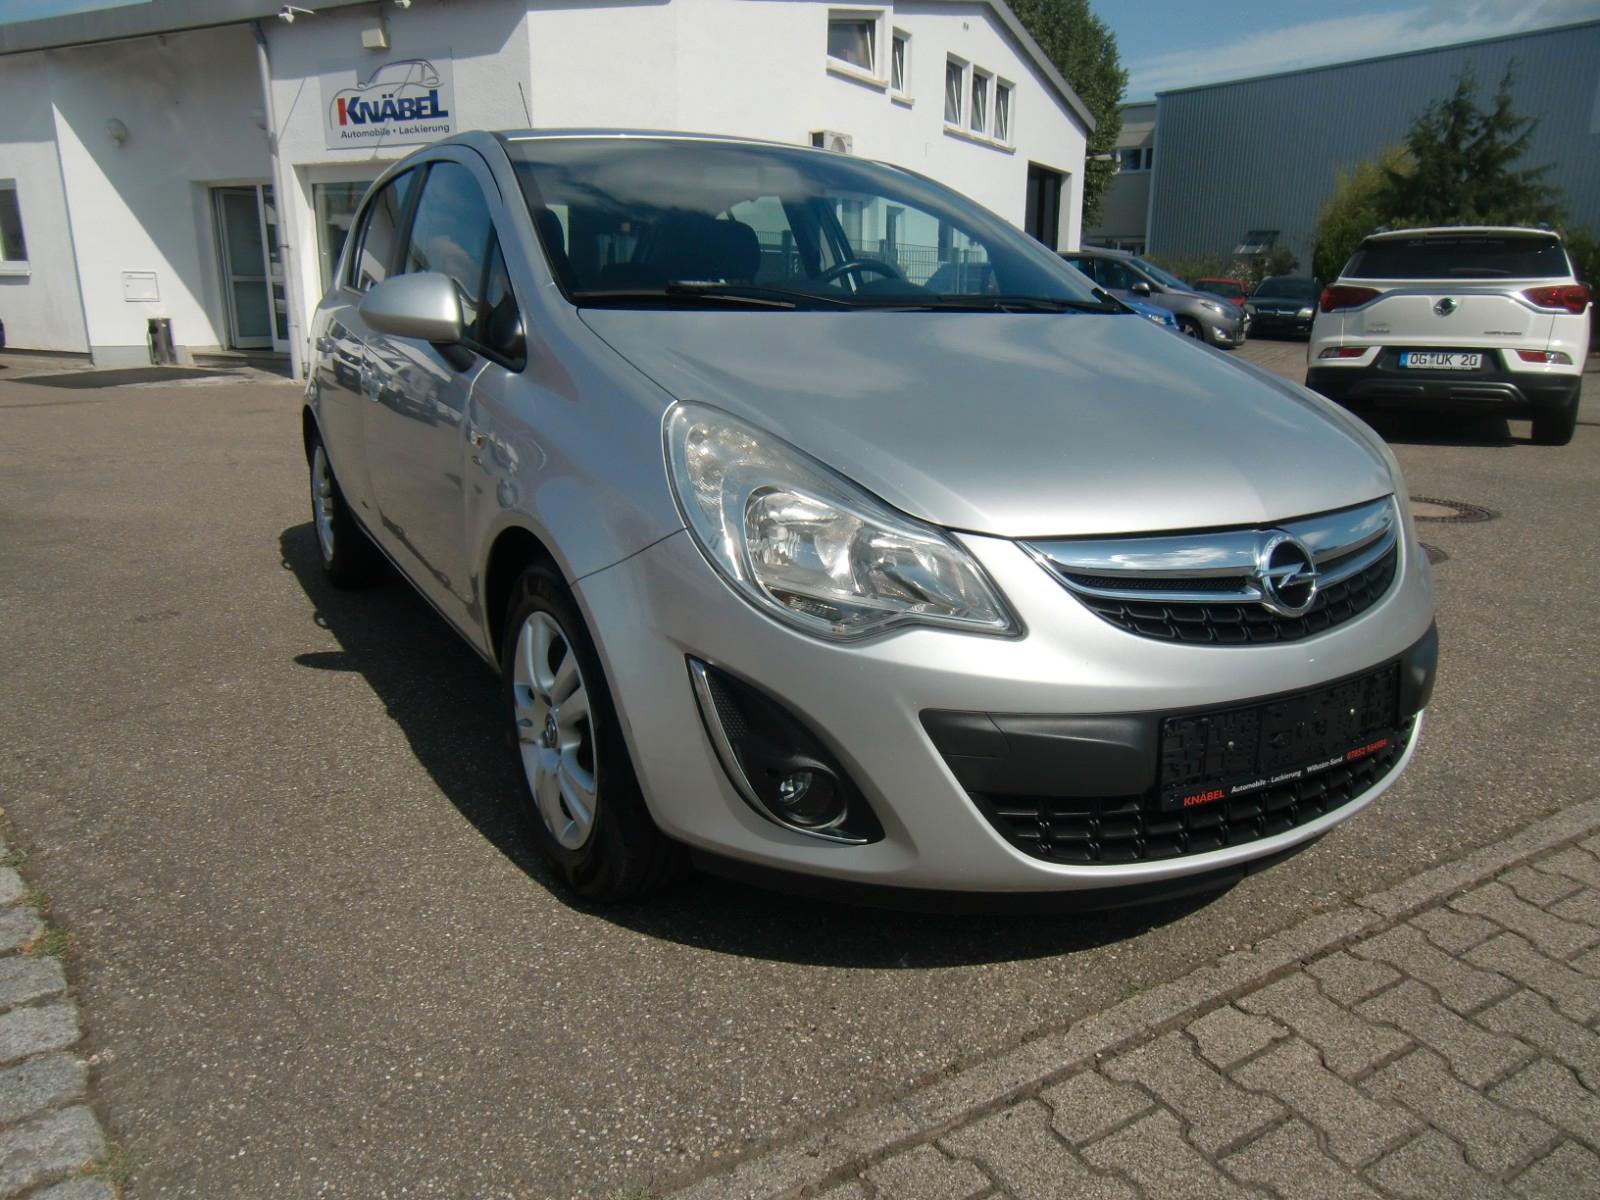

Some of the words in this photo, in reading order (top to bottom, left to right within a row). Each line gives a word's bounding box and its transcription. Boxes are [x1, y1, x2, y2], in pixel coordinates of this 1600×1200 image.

[337, 89, 448, 126] KNÄBEL
[341, 128, 391, 139] Automobile
[399, 124, 450, 135] Lackierung
[1410, 353, 1427, 365] OG
[1436, 353, 1453, 365] UK
[1461, 354, 1478, 366] 20
[1183, 789, 1225, 807] KNÄBEL
[1231, 779, 1266, 793] Automobile
[1271, 770, 1302, 783] Lackierung
